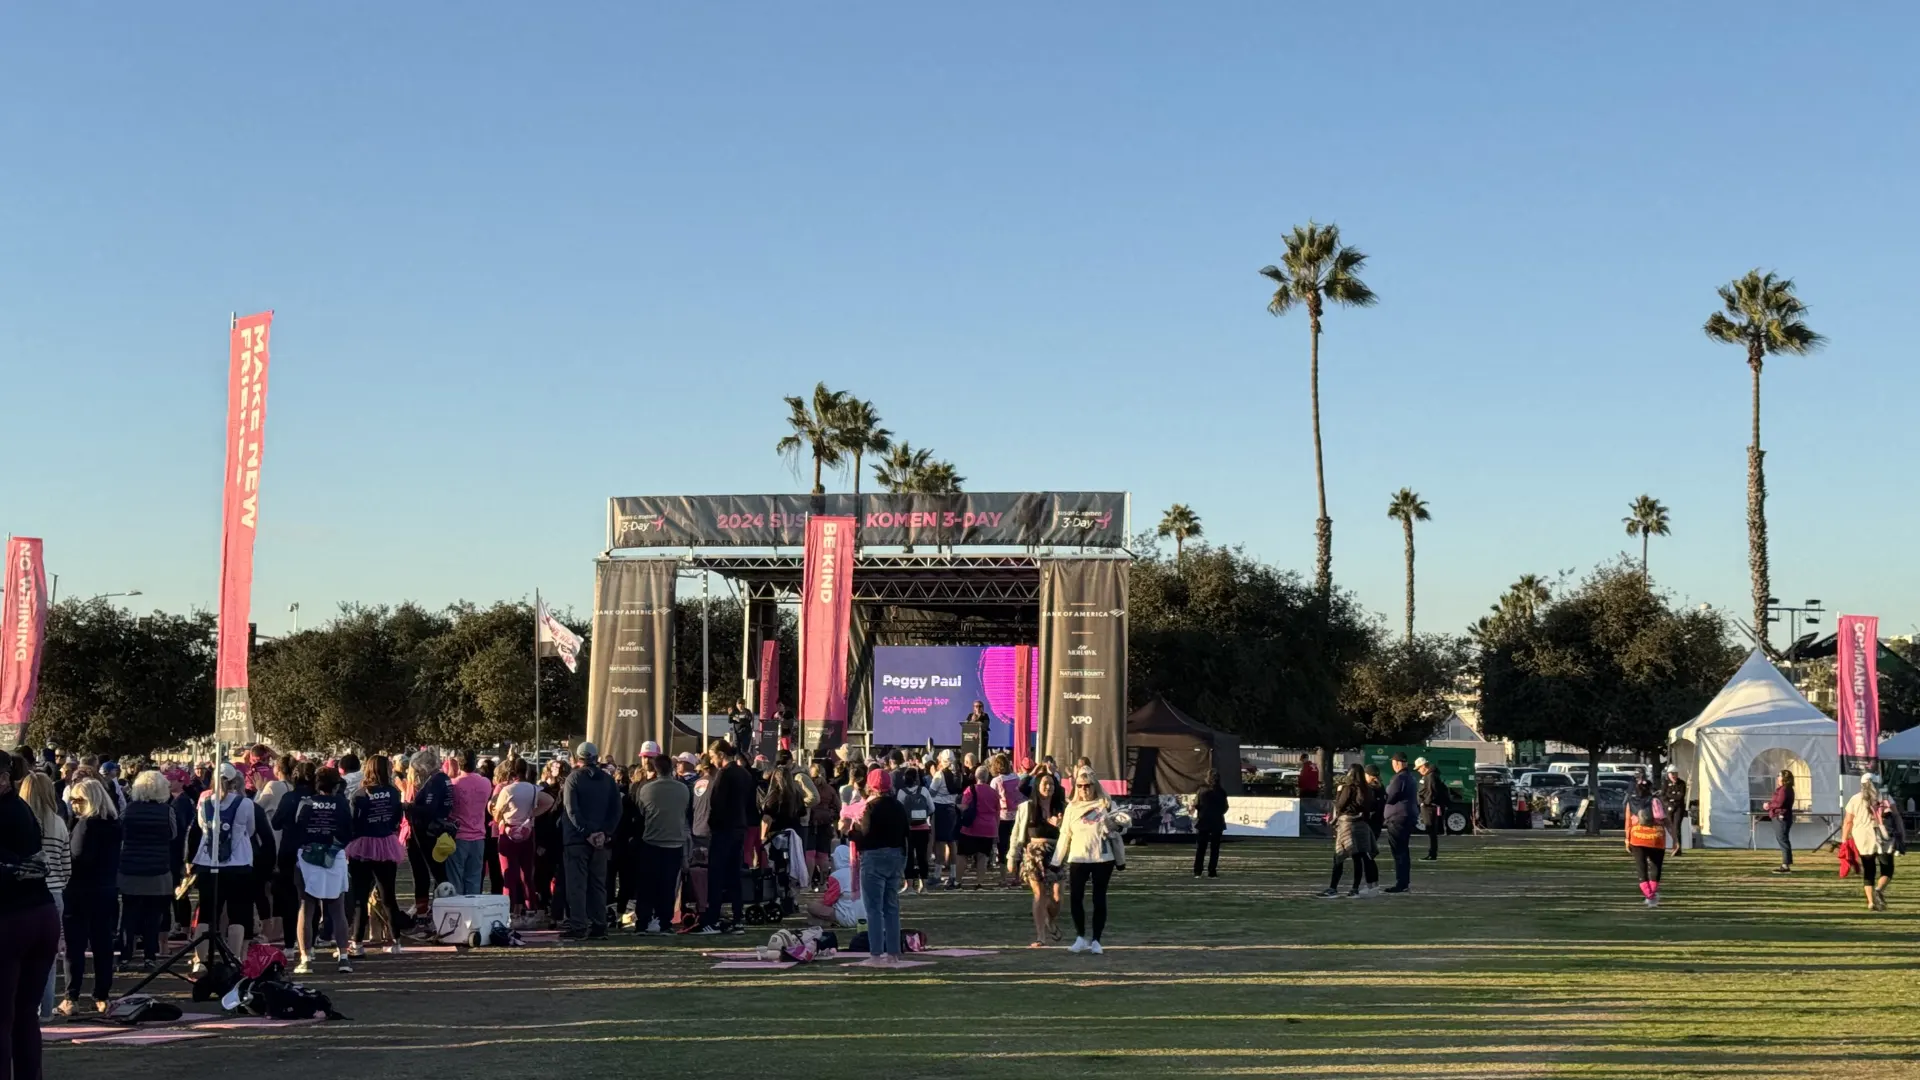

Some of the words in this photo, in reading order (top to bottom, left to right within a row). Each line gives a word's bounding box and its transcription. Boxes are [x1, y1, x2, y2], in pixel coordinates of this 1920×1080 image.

[250, 324, 265, 432] MAKE
[241, 442, 258, 529] NEW
[717, 513, 764, 528] 2024
[866, 512, 937, 528] KOMEN
[943, 511, 1003, 528] 3-DAY
[1061, 517, 1095, 529] 3-Day
[621, 521, 650, 532] 3-Day
[822, 522, 838, 549] BE
[19, 543, 31, 570] NO
[820, 554, 836, 604] KIND
[882, 674, 927, 689] Peggy
[931, 675, 962, 687] Paul
[611, 686, 647, 695] Walgreens
[1062, 692, 1101, 701] Walgreens
[882, 696, 932, 707] Celebrating
[934, 696, 949, 705] her
[618, 709, 638, 717] XPO
[1071, 715, 1093, 724] XPO
[1855, 699, 1866, 756] CENTER
[369, 791, 391, 800] 2024
[312, 802, 336, 810] 2024
